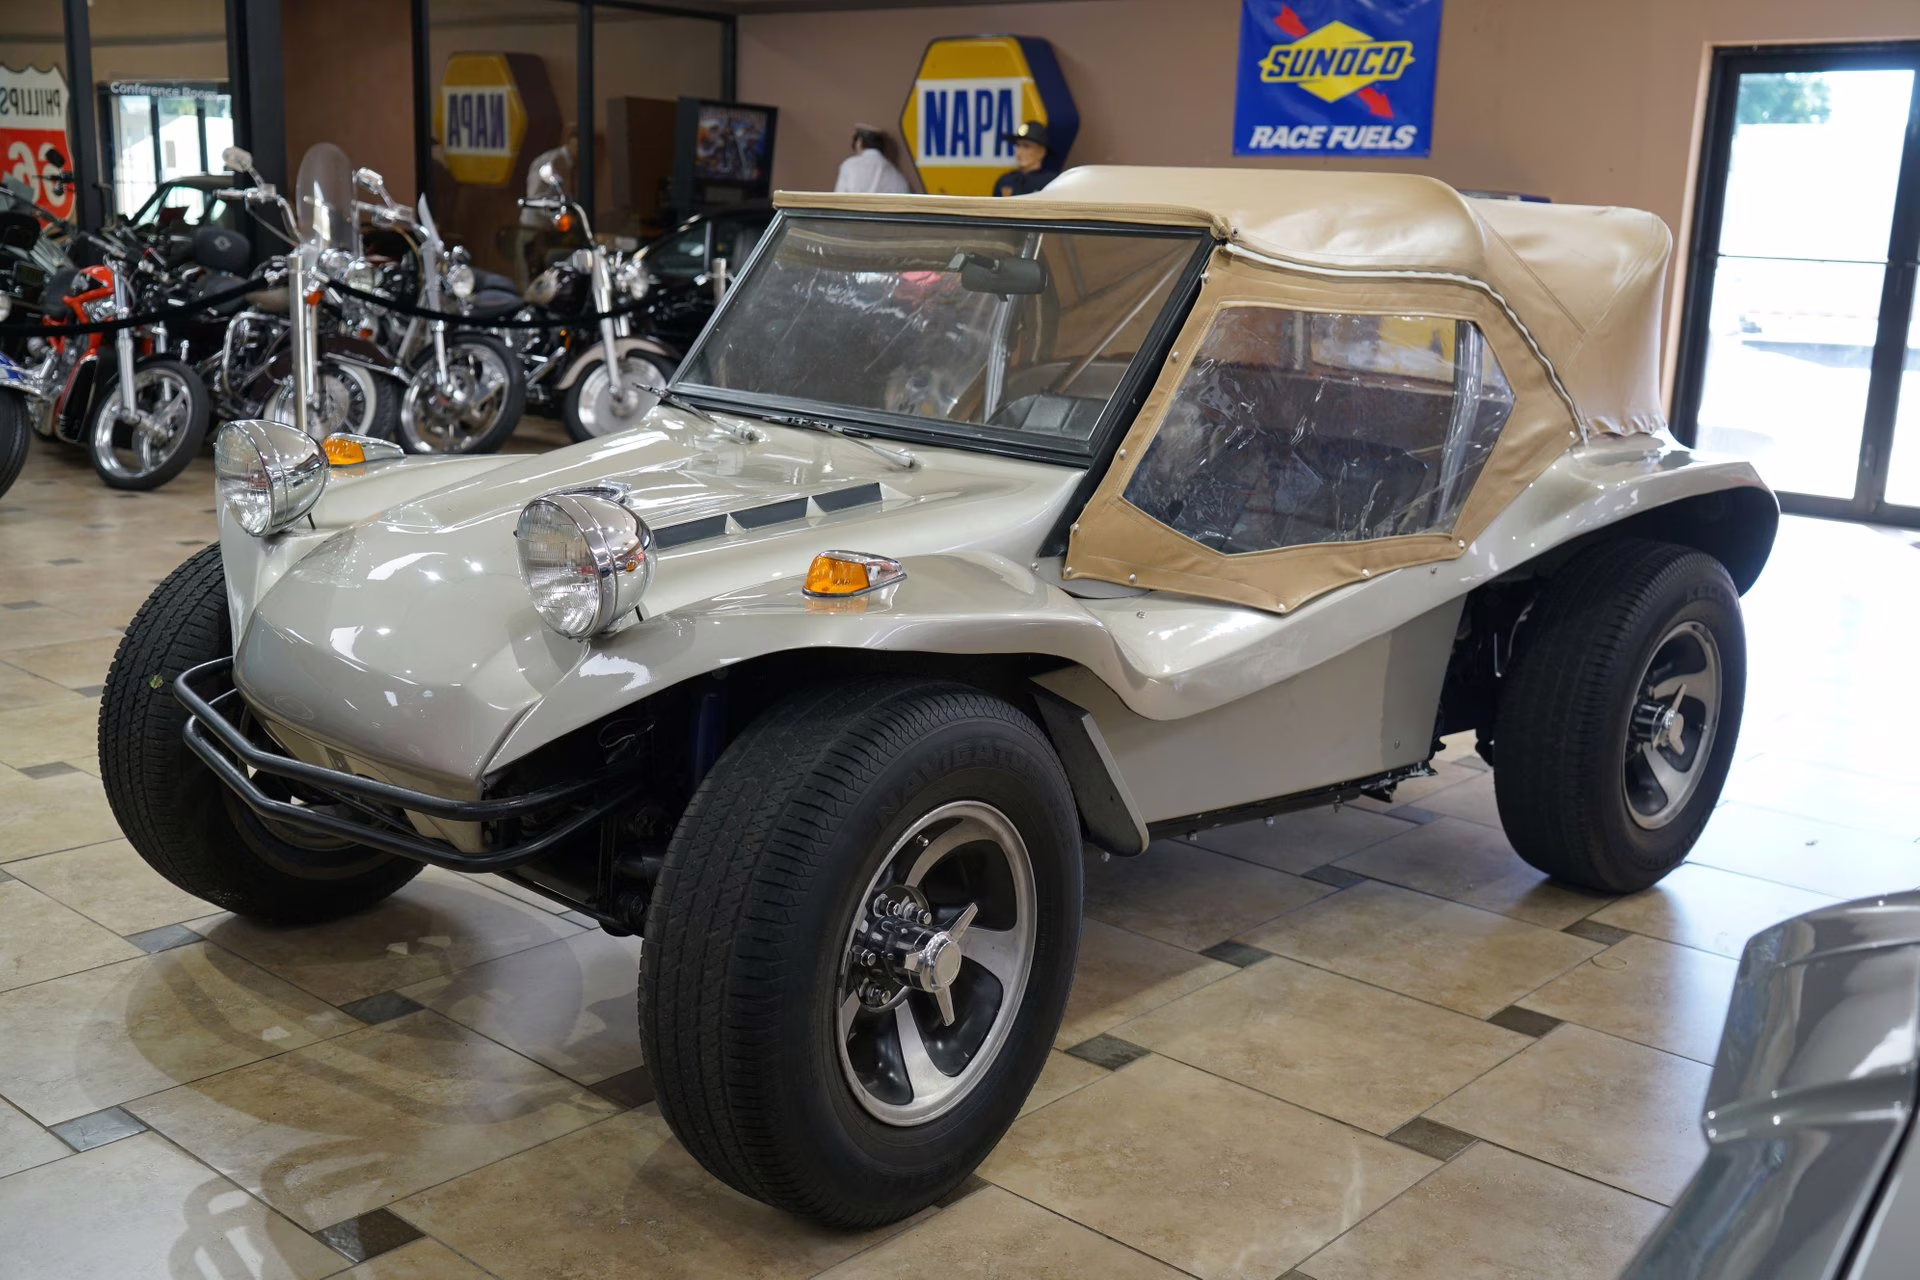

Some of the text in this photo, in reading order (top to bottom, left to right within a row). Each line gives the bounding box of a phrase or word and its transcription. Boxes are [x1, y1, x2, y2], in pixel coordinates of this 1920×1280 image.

[1264, 46, 1407, 78] SUNOCO
[110, 81, 180, 97] Conference
[925, 89, 1015, 157] NAPA
[1249, 125, 1418, 149] RACE FUELS
